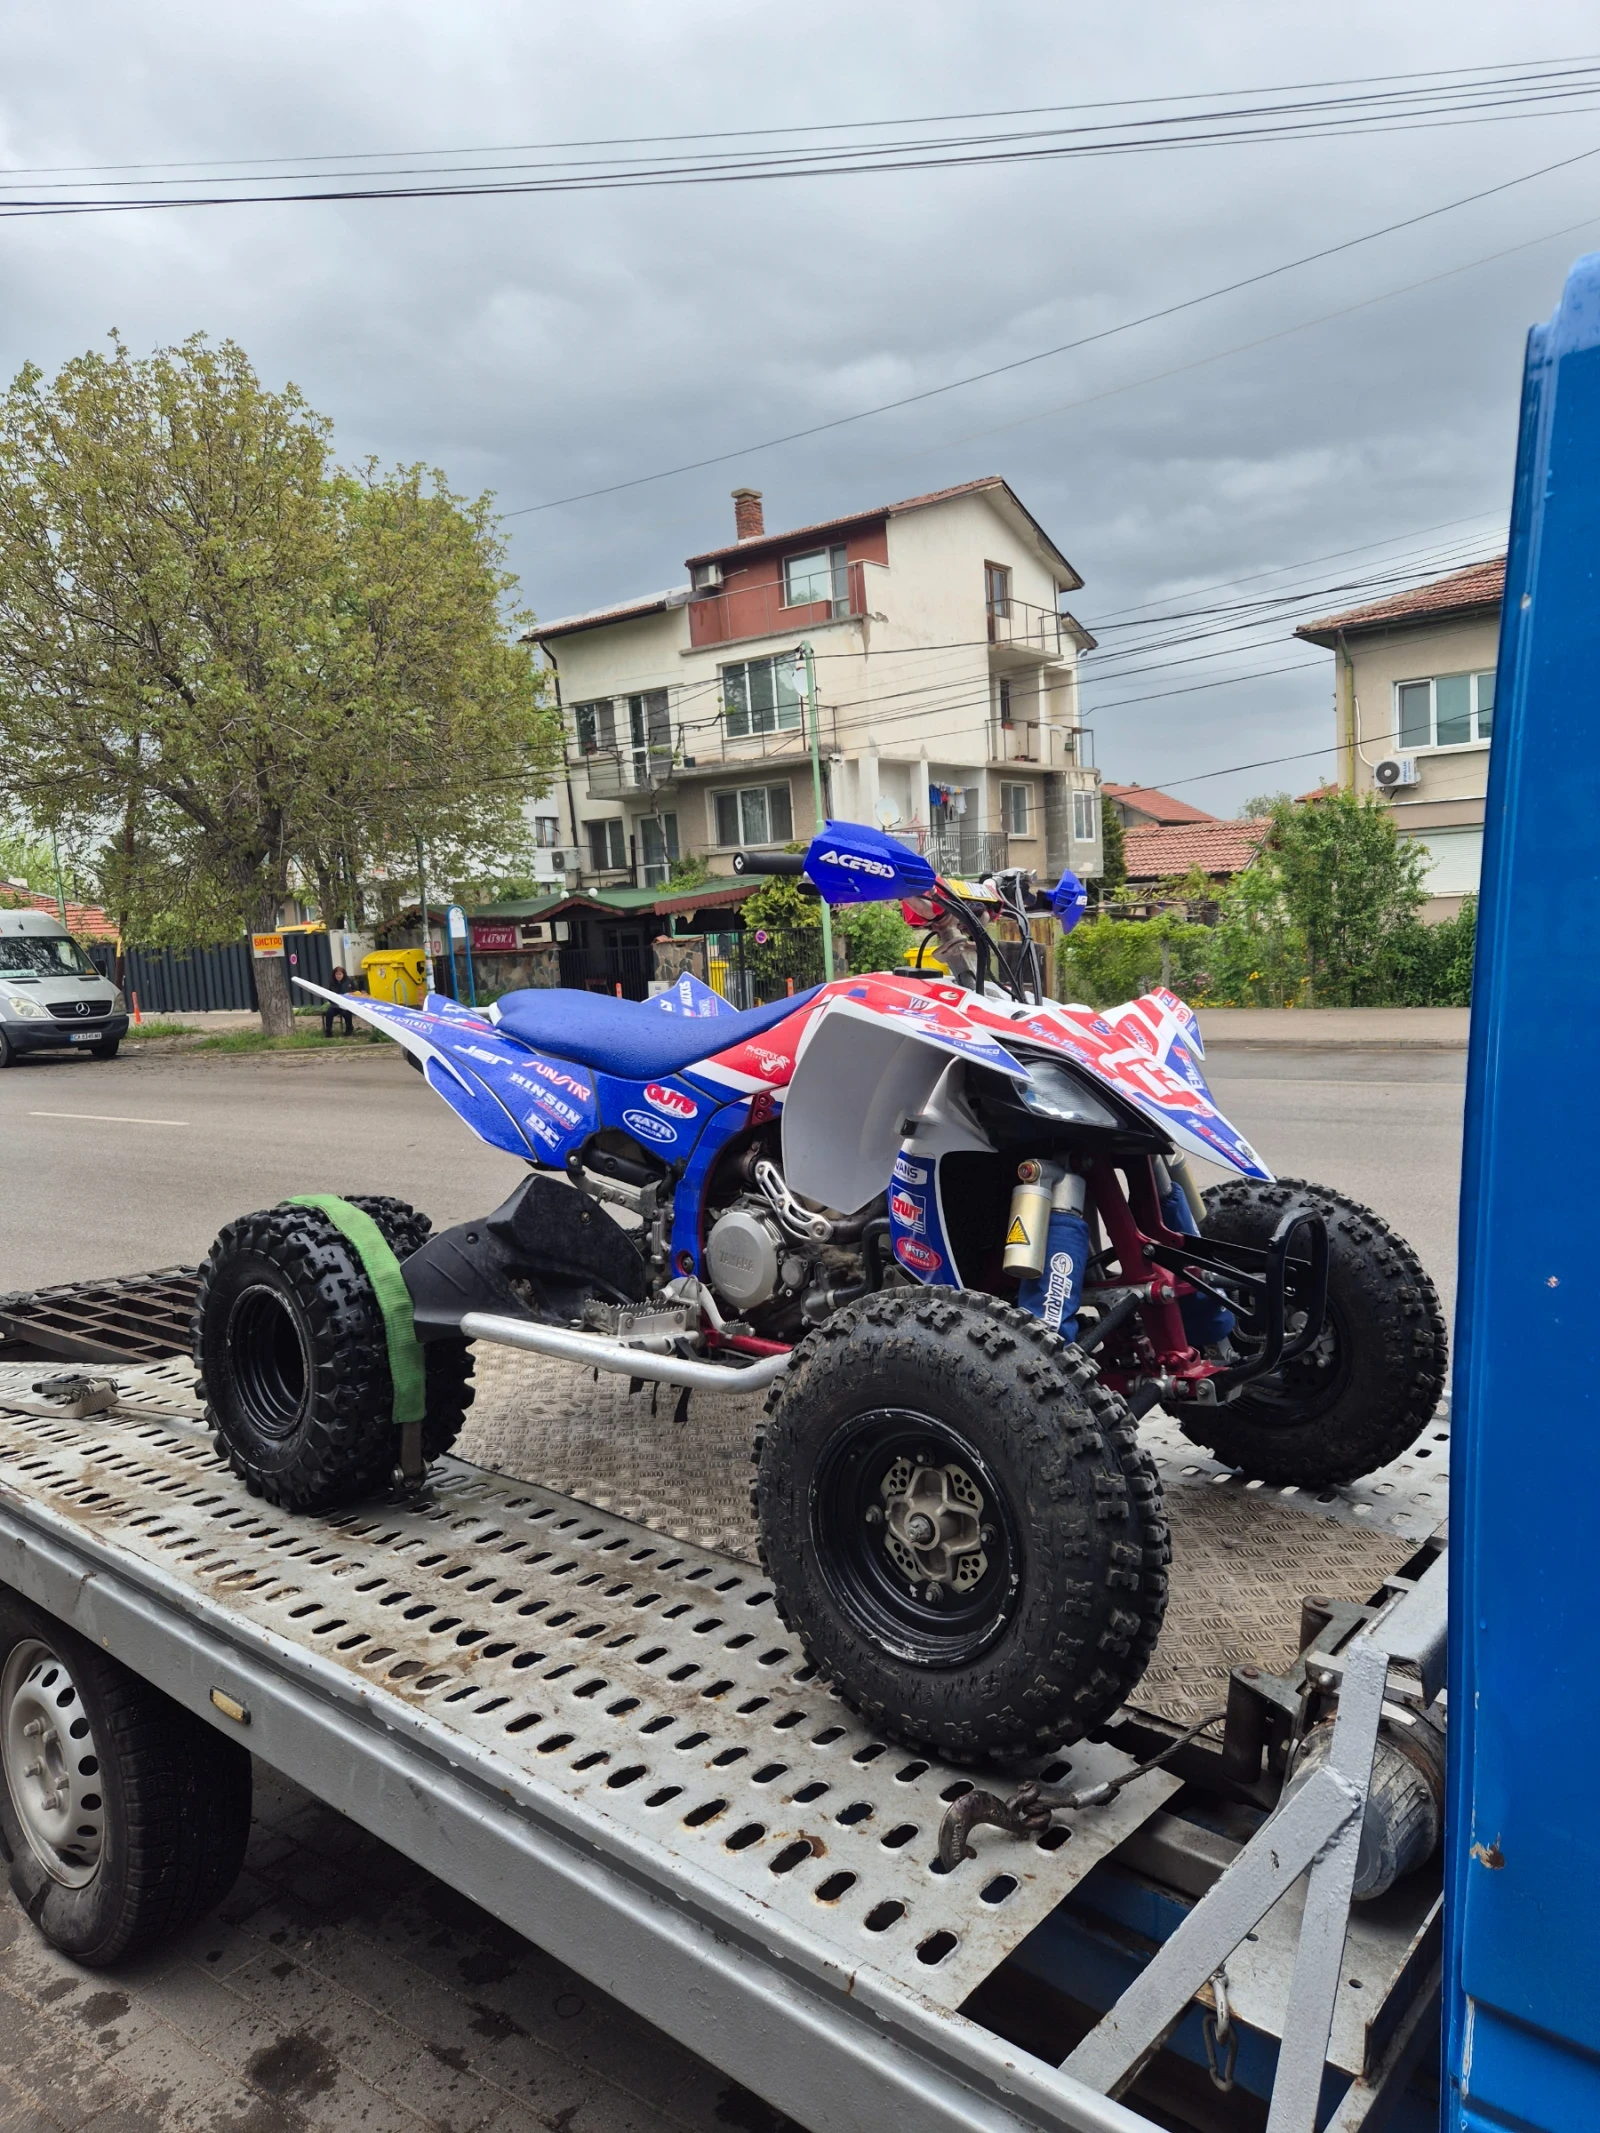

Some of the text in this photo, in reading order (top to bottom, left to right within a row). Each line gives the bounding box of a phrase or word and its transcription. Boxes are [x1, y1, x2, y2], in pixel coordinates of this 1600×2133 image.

[819, 850, 895, 878] ACERBIS
[254, 936, 283, 947] БИСТРО
[924, 1023, 958, 1037] CST
[745, 1045, 779, 1060] PHOENIX
[522, 1061, 592, 1102] SUNSTAR
[508, 1072, 582, 1125] HINSON
[646, 1083, 698, 1115] GUTS
[891, 1195, 924, 1221] DWT
